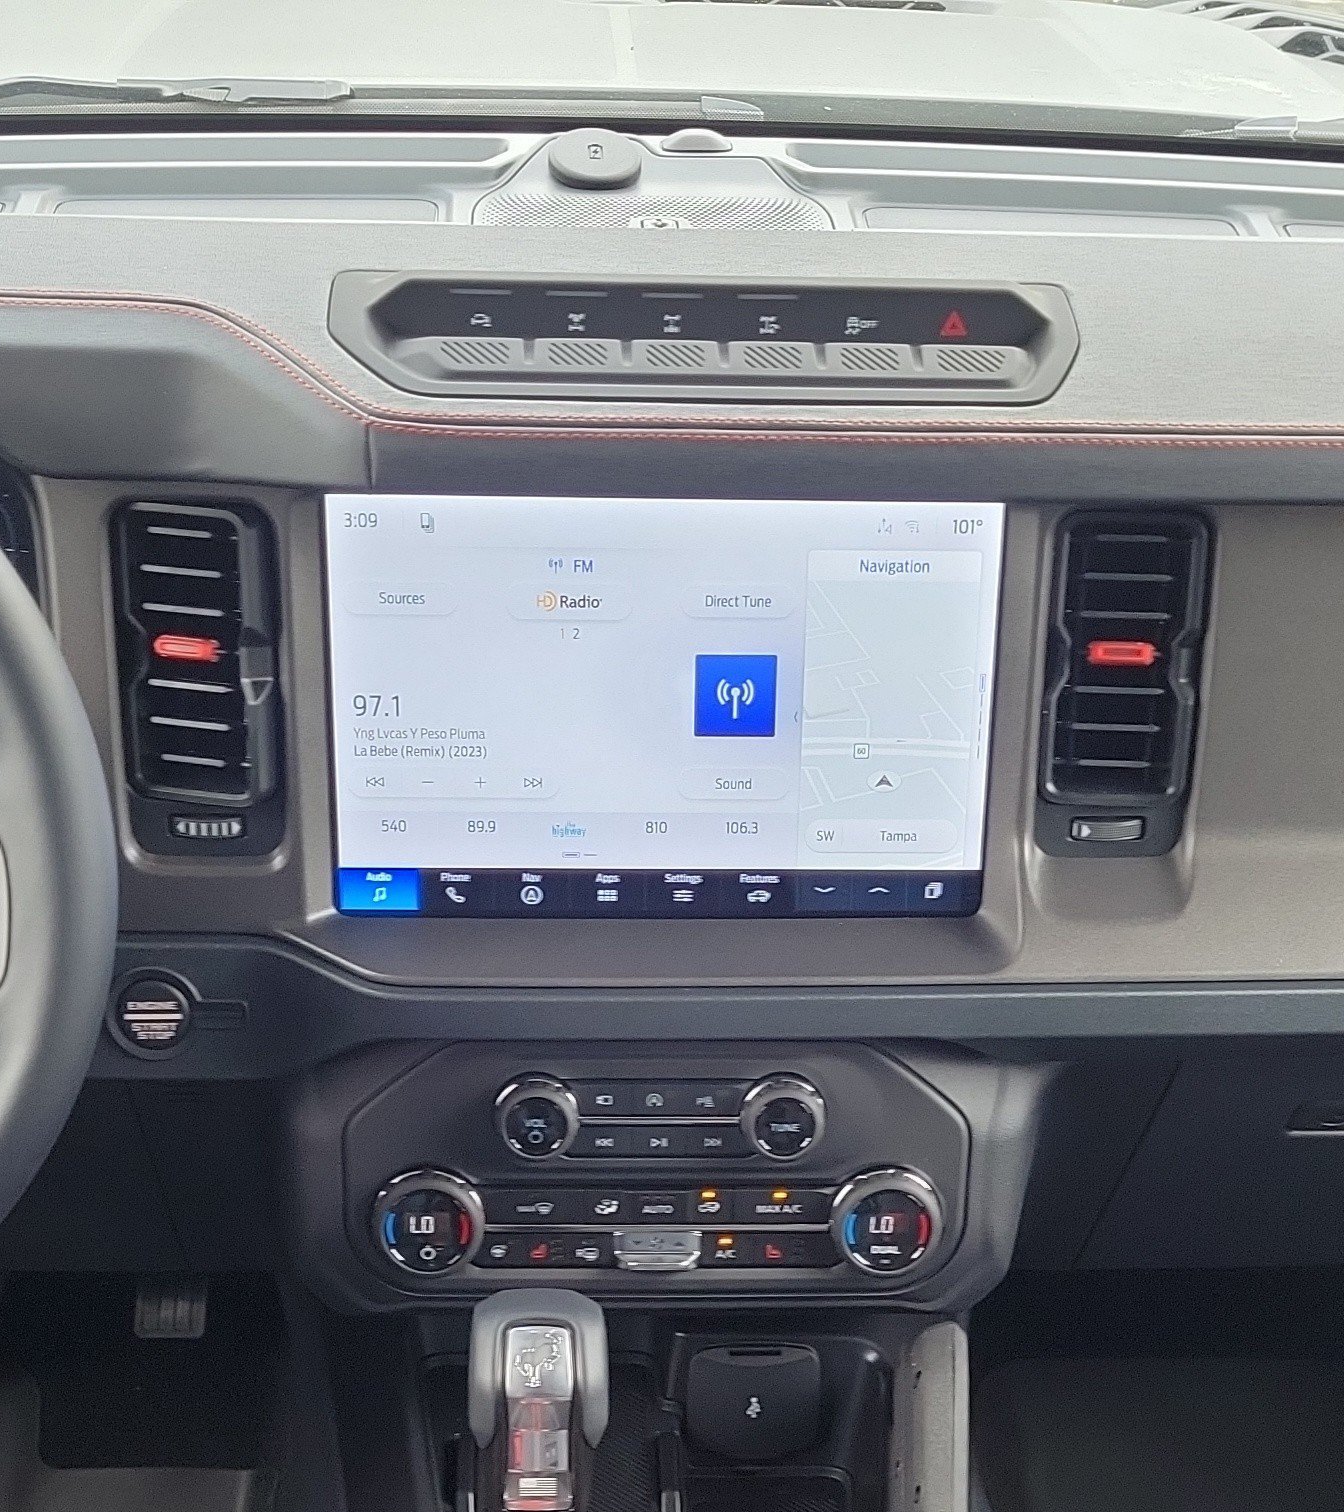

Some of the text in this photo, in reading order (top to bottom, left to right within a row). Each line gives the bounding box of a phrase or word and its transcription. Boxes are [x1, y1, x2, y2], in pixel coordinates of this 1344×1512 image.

[343, 513, 378, 528] 3:09
[953, 519, 984, 534] 101°
[573, 560, 593, 573] FM
[859, 559, 930, 575] Navigation
[378, 592, 426, 605] Sources
[559, 595, 601, 609] Radio
[704, 595, 772, 608] Direct Tune
[572, 629, 580, 640] 2
[352, 695, 401, 717] 97.1
[353, 728, 486, 741] Yng Lvcas Y Peso Pluma
[354, 745, 487, 759] La Bebe (Remix) (2023)
[715, 777, 752, 791] Sound
[381, 820, 407, 833] 540
[467, 820, 496, 833] 89.9
[645, 821, 668, 834] 810
[725, 822, 759, 835] 106.3
[816, 830, 835, 842] SW
[880, 831, 917, 843] Tampa
[366, 872, 392, 882] Audio
[440, 872, 471, 882] Phone
[521, 873, 543, 882] Nav
[595, 873, 621, 885] Apps
[664, 873, 704, 884] Settings
[739, 873, 781, 884] Features
[127, 1001, 179, 1010] ENGINE
[131, 1023, 179, 1031] START
[137, 1031, 176, 1039] STOP
[769, 1123, 801, 1133] TUNE
[641, 1205, 674, 1214] AUTO
